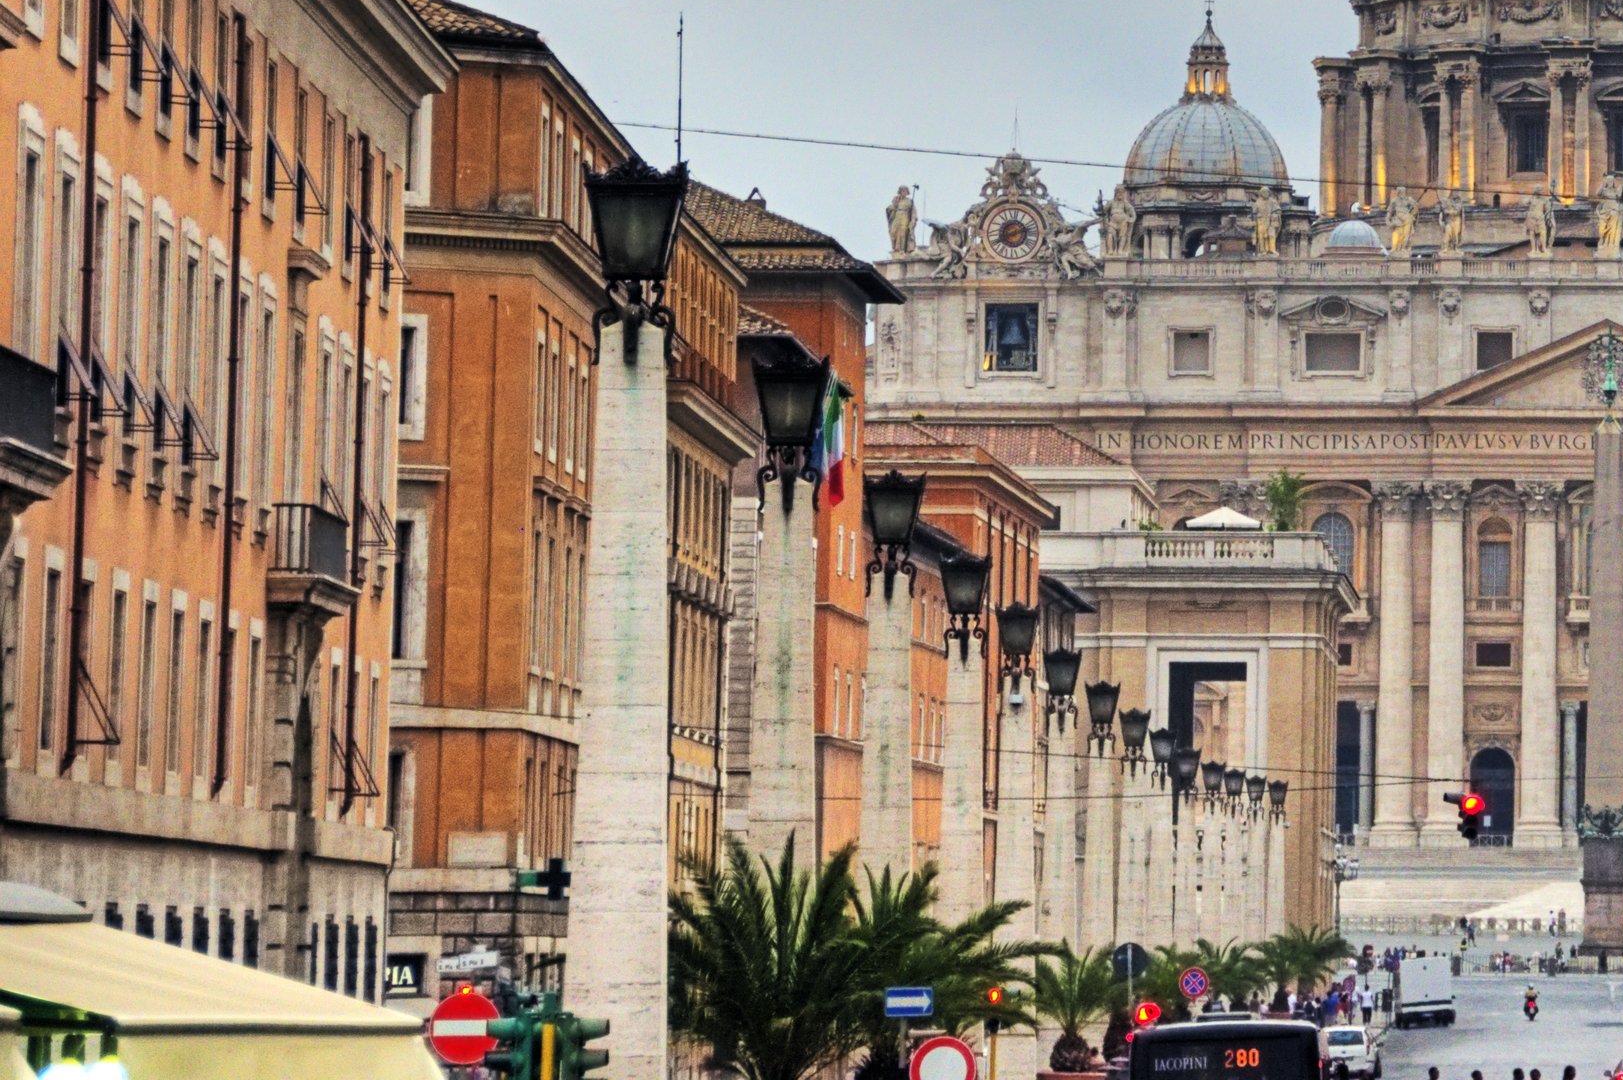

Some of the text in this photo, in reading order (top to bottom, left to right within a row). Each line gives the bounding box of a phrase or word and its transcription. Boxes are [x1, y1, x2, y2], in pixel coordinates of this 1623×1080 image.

[1096, 433, 1123, 449] IN
[1132, 433, 1243, 450] HONOREM
[1250, 433, 1360, 450] PRINCIPIS
[1364, 433, 1432, 450] APOST
[1435, 433, 1506, 450] PAVLVS
[1154, 1056, 1208, 1072] IACOPINI
[1224, 1047, 1260, 1069] 280
